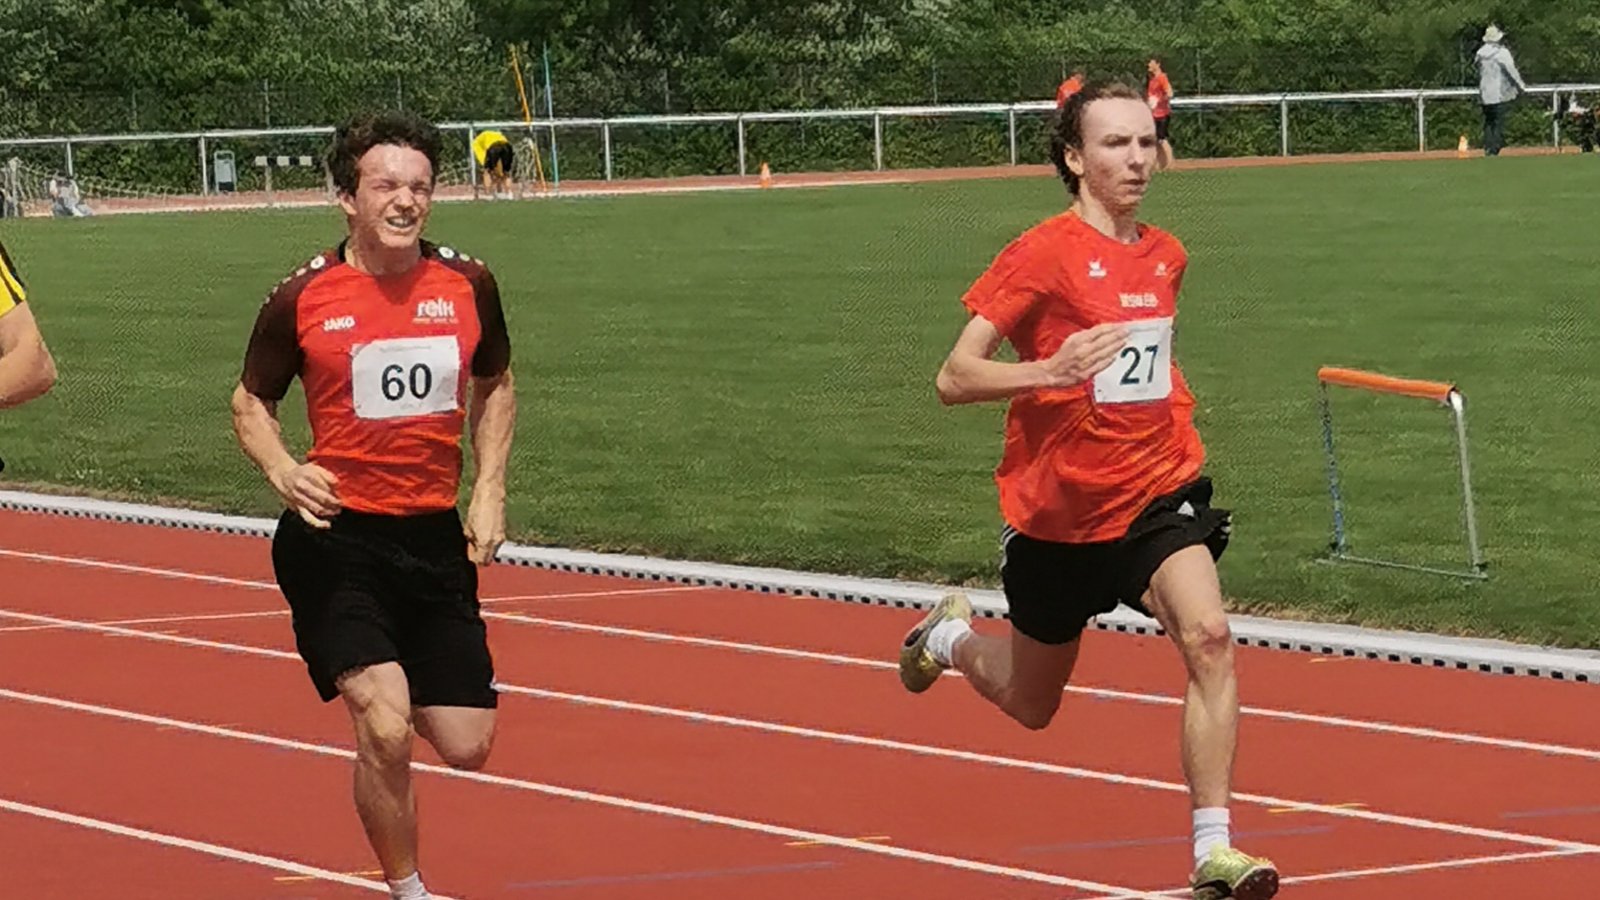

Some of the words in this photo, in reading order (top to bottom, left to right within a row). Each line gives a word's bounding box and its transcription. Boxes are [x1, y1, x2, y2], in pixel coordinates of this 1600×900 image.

[323, 315, 356, 332] JAKO
[382, 364, 432, 401] 60
[1120, 345, 1159, 385] 27
